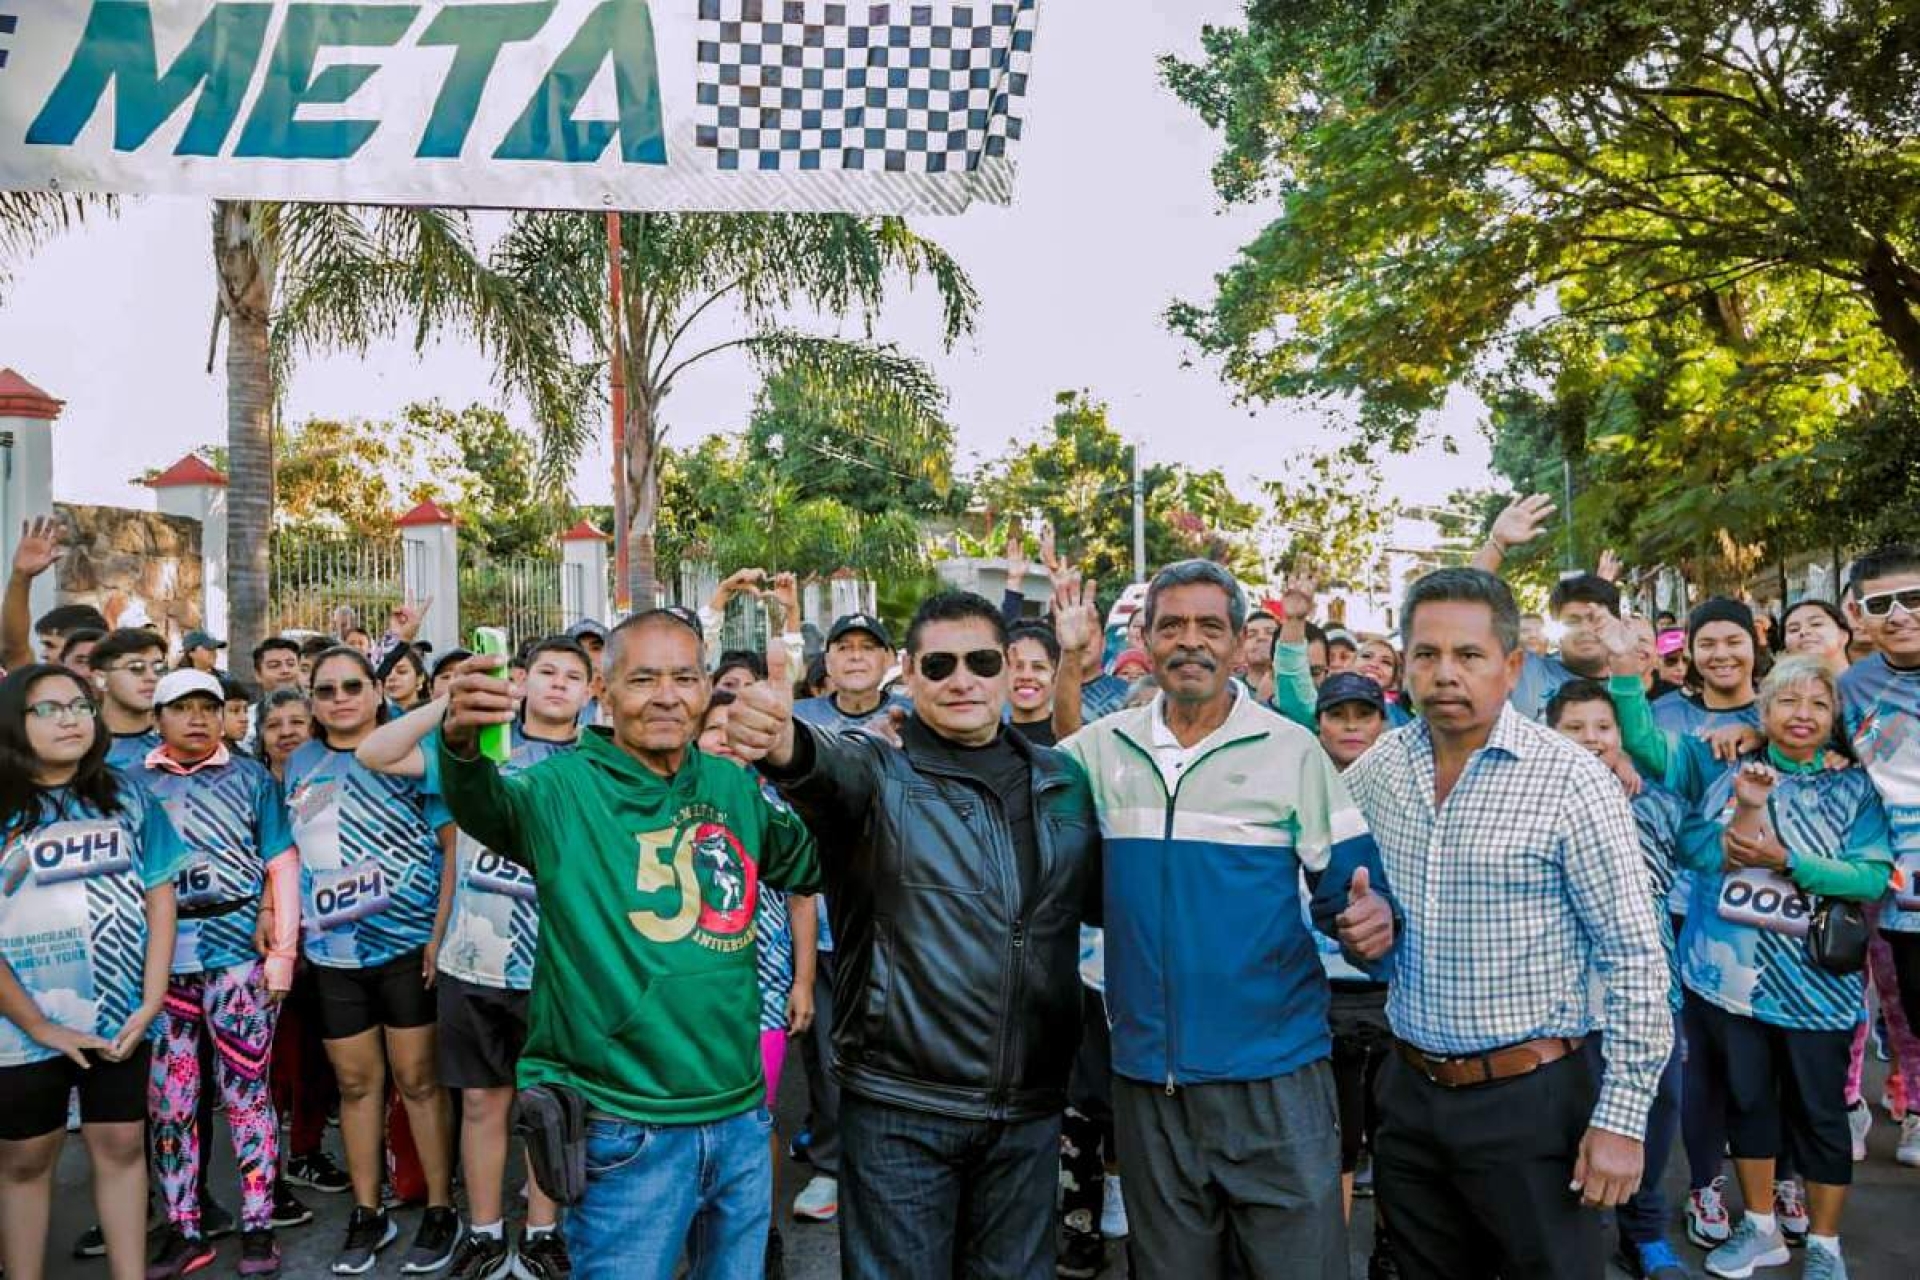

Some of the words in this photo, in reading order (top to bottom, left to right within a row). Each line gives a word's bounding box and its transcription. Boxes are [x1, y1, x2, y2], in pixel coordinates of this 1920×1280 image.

[25, 0, 668, 165] META
[34, 831, 118, 867] 044
[477, 850, 533, 885] 05
[316, 871, 381, 915] 024
